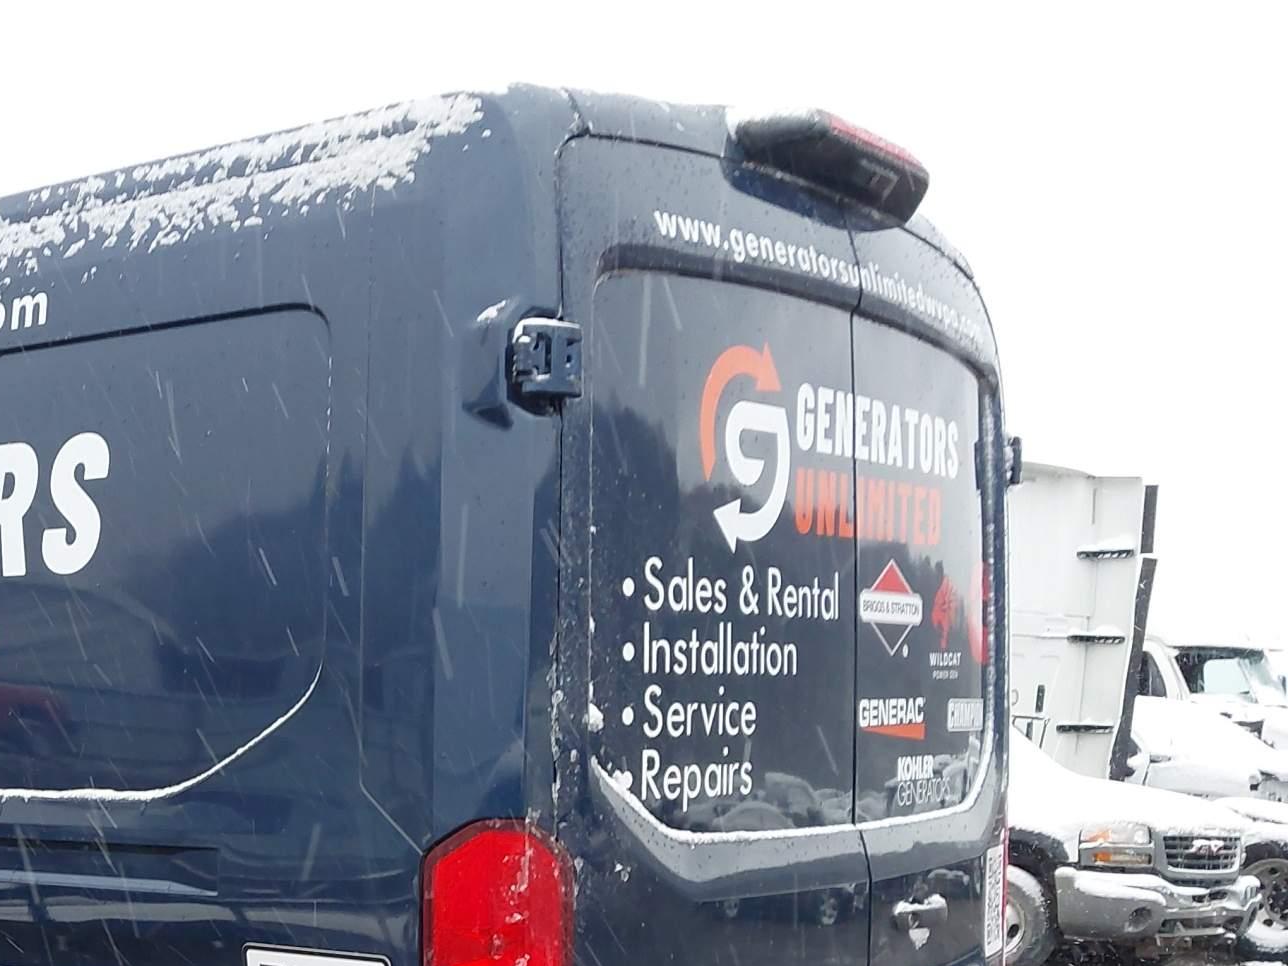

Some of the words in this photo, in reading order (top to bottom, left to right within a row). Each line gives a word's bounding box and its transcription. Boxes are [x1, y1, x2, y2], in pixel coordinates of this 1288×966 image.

[796, 383, 959, 479] GENERATORS
[794, 467, 941, 545] UNLIMITED
[644, 556, 727, 614] Sales
[739, 564, 759, 615] &
[767, 566, 839, 620] Rental
[643, 621, 797, 676] Installation
[929, 652, 961, 666] WILDCAT
[643, 684, 756, 738] Service
[860, 697, 924, 727] GENERAC
[641, 746, 753, 813] Repairs
[897, 776, 951, 806] GENERATORS
[898, 754, 934, 782] KOHLER
